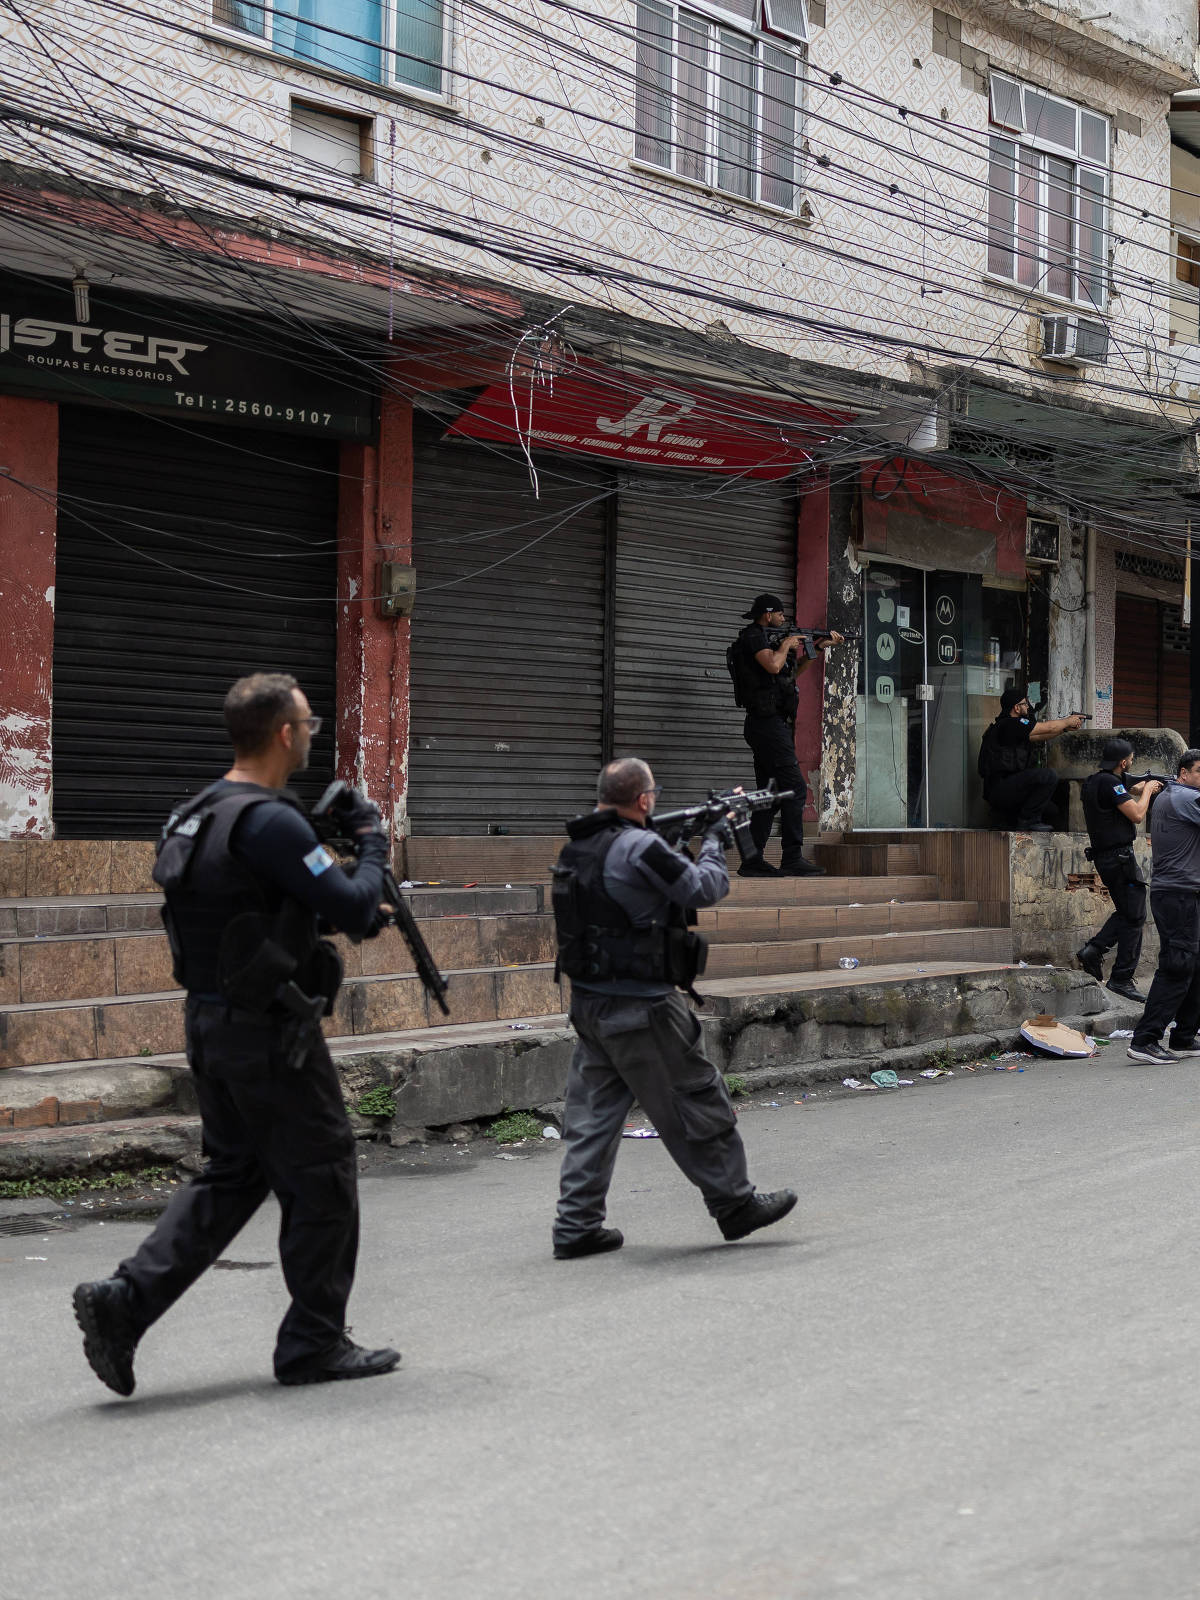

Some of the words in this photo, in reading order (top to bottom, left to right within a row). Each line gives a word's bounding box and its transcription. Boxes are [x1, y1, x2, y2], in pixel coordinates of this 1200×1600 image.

[27, 354, 79, 369] ROUPAS
[83, 362, 91, 371] E
[93, 363, 173, 382] ACESSÓRIOS
[225, 399, 332, 426] 2560-9107
[579, 437, 622, 451] FEMININO
[664, 450, 697, 462] FITNESS
